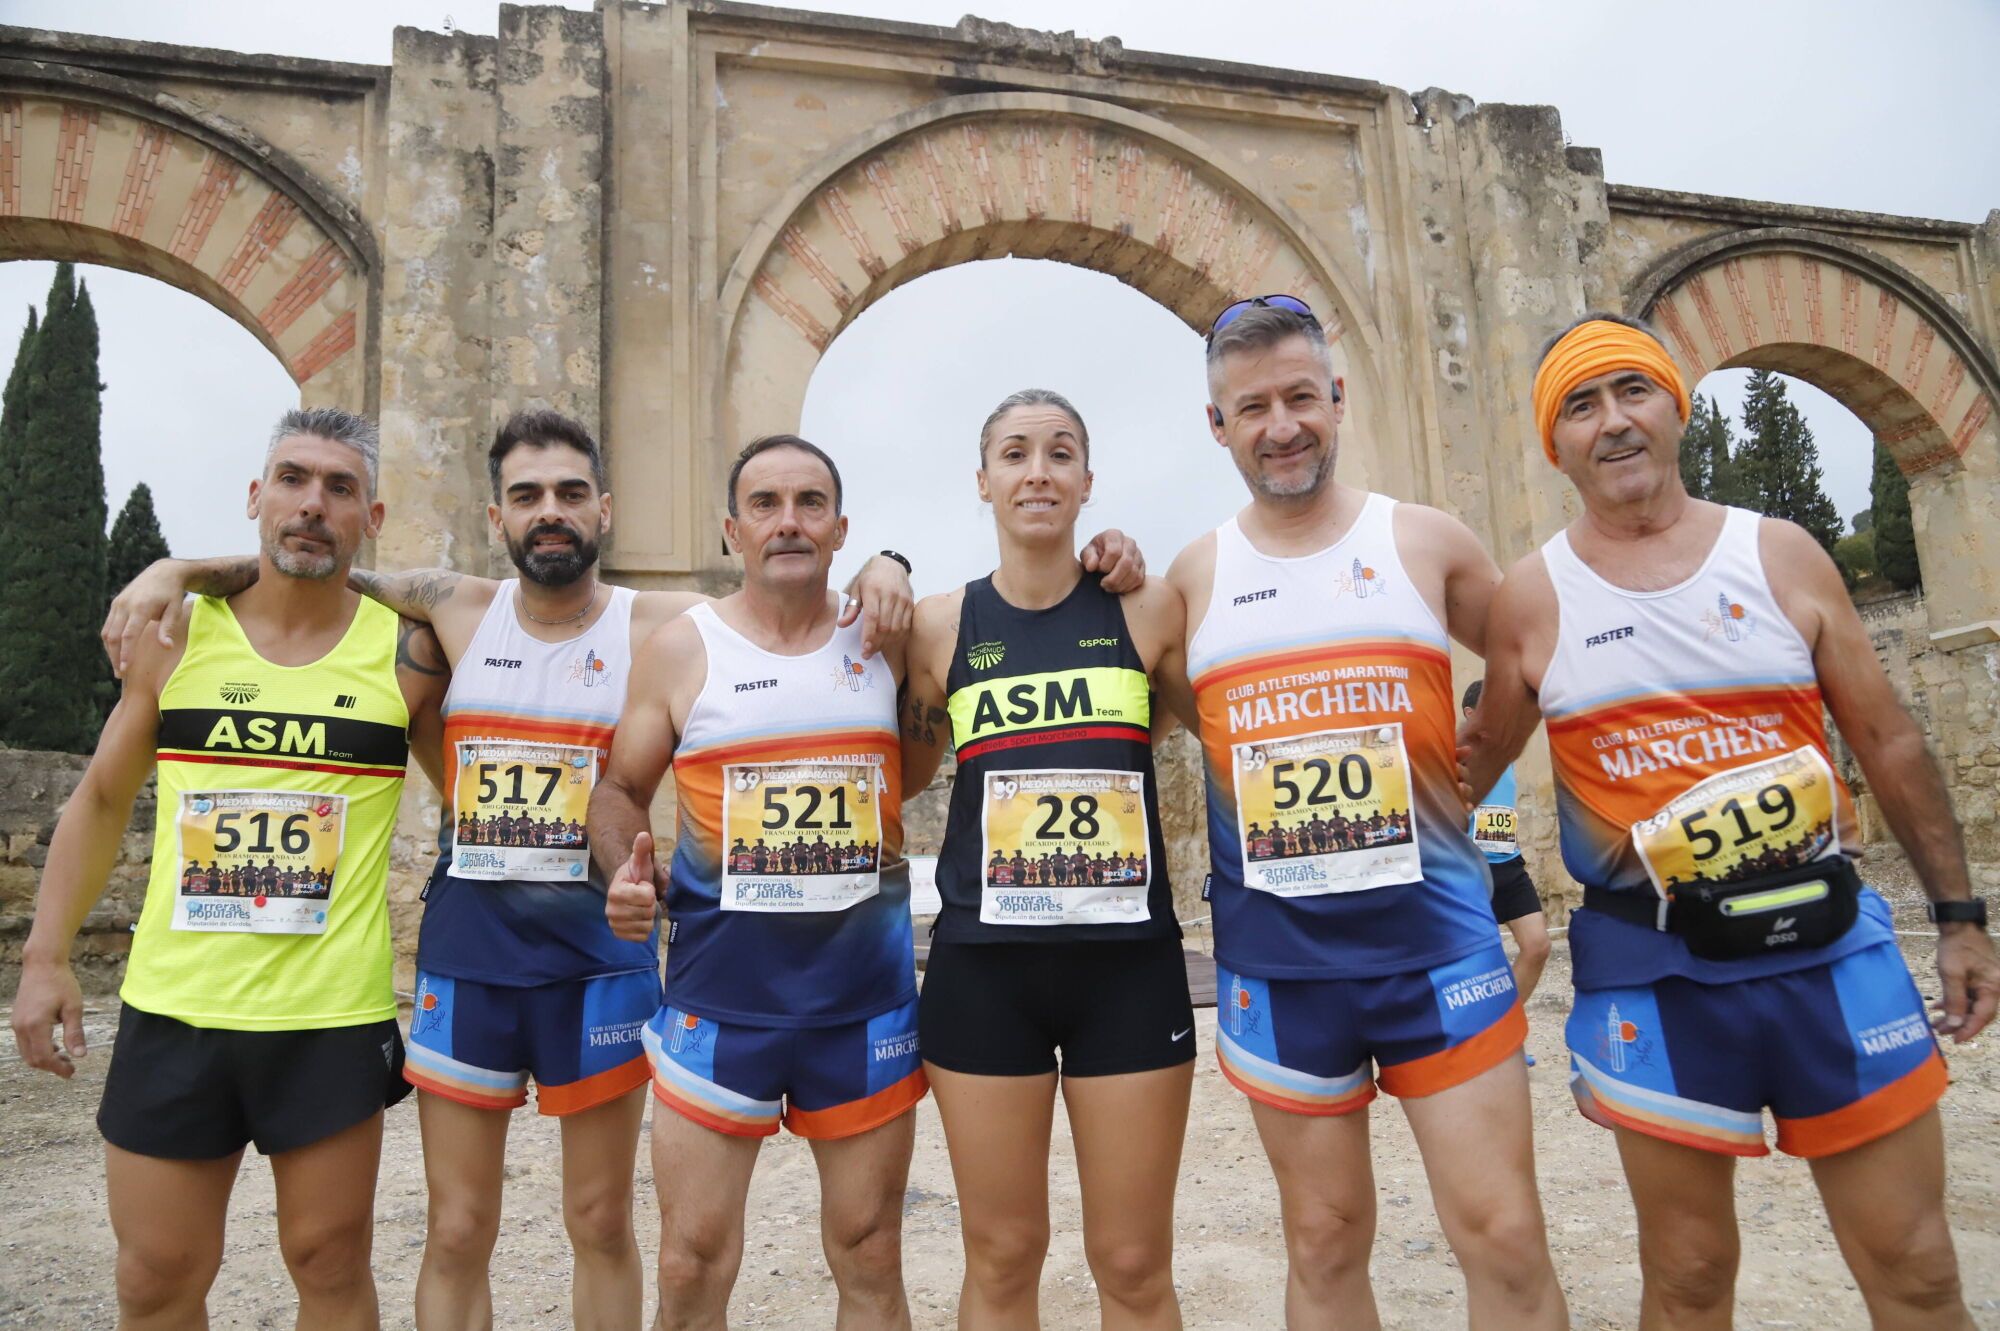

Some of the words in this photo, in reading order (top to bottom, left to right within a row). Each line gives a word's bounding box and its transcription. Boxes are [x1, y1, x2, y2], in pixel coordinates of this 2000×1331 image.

[1233, 588, 1277, 607] FASTER
[1079, 638, 1119, 648] GSPORT
[1586, 626, 1634, 649] FASTER
[483, 658, 522, 669] FASTER
[734, 679, 778, 693] FASTER
[1226, 683, 1255, 701] CLUB
[1258, 670, 1331, 694] ATLETISMO
[1333, 666, 1409, 680] MARATHON
[971, 677, 1094, 735] ASM
[1096, 708, 1123, 717] Team
[1228, 682, 1414, 734] MARCHENA
[204, 716, 326, 755] ASM
[328, 750, 353, 759] Team
[1592, 732, 1623, 750] CLUB
[1626, 716, 1708, 743] ATLETISMO
[463, 750, 477, 766] 9
[477, 764, 562, 806] 517
[763, 771, 797, 780] MEDIA
[1020, 780, 1053, 789] MEDIA
[1273, 754, 1372, 810] 520
[761, 786, 852, 829] 521
[1035, 795, 1100, 840] 28
[1487, 813, 1512, 827] 105
[1680, 784, 1796, 861] 519
[214, 813, 310, 854] 516
[462, 860, 506, 869] opulares
[736, 882, 793, 891] carreras
[1267, 871, 1327, 886] opulares
[996, 896, 1052, 904] carreras
[1445, 974, 1514, 1010] MARCHENA
[604, 1023, 632, 1031] ATLETISMO
